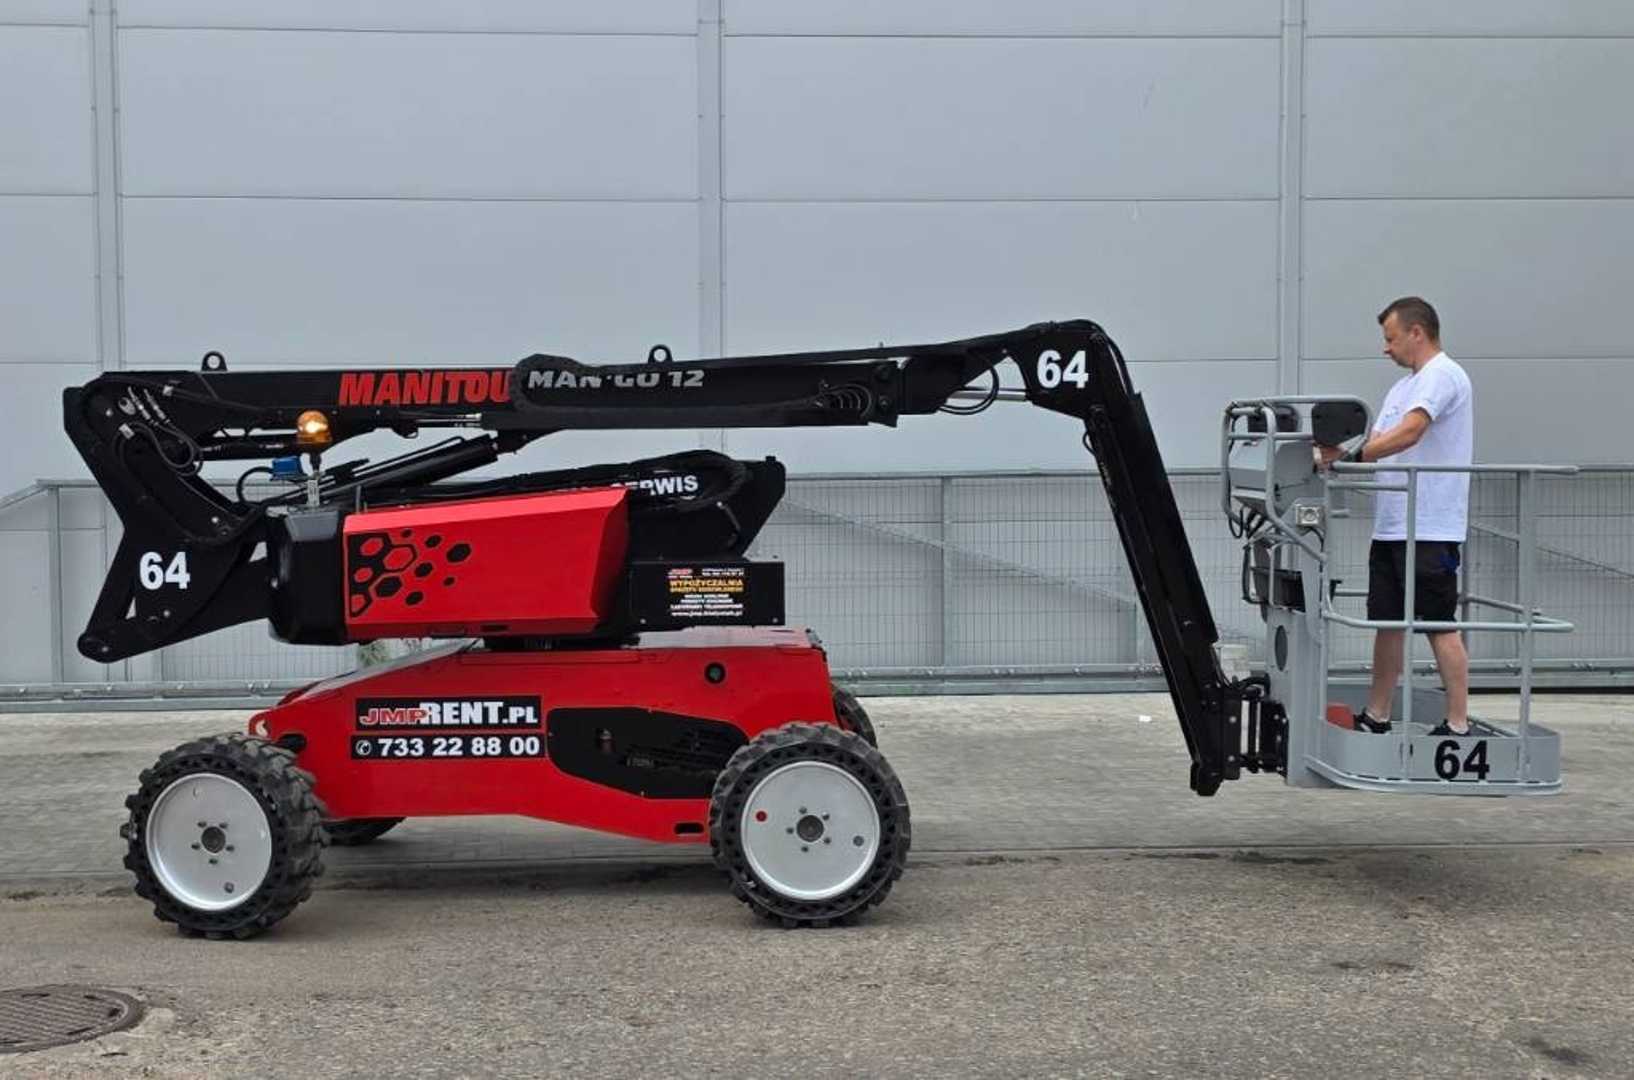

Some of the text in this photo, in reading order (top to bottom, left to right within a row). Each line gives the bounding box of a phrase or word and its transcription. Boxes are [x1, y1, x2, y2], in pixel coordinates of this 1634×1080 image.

[338, 369, 512, 407] MANITOU
[669, 369, 705, 388] 12
[1037, 350, 1089, 389] 64
[139, 551, 191, 591] 64
[377, 736, 541, 757] 733 22 88 00
[1434, 739, 1490, 780] 64
